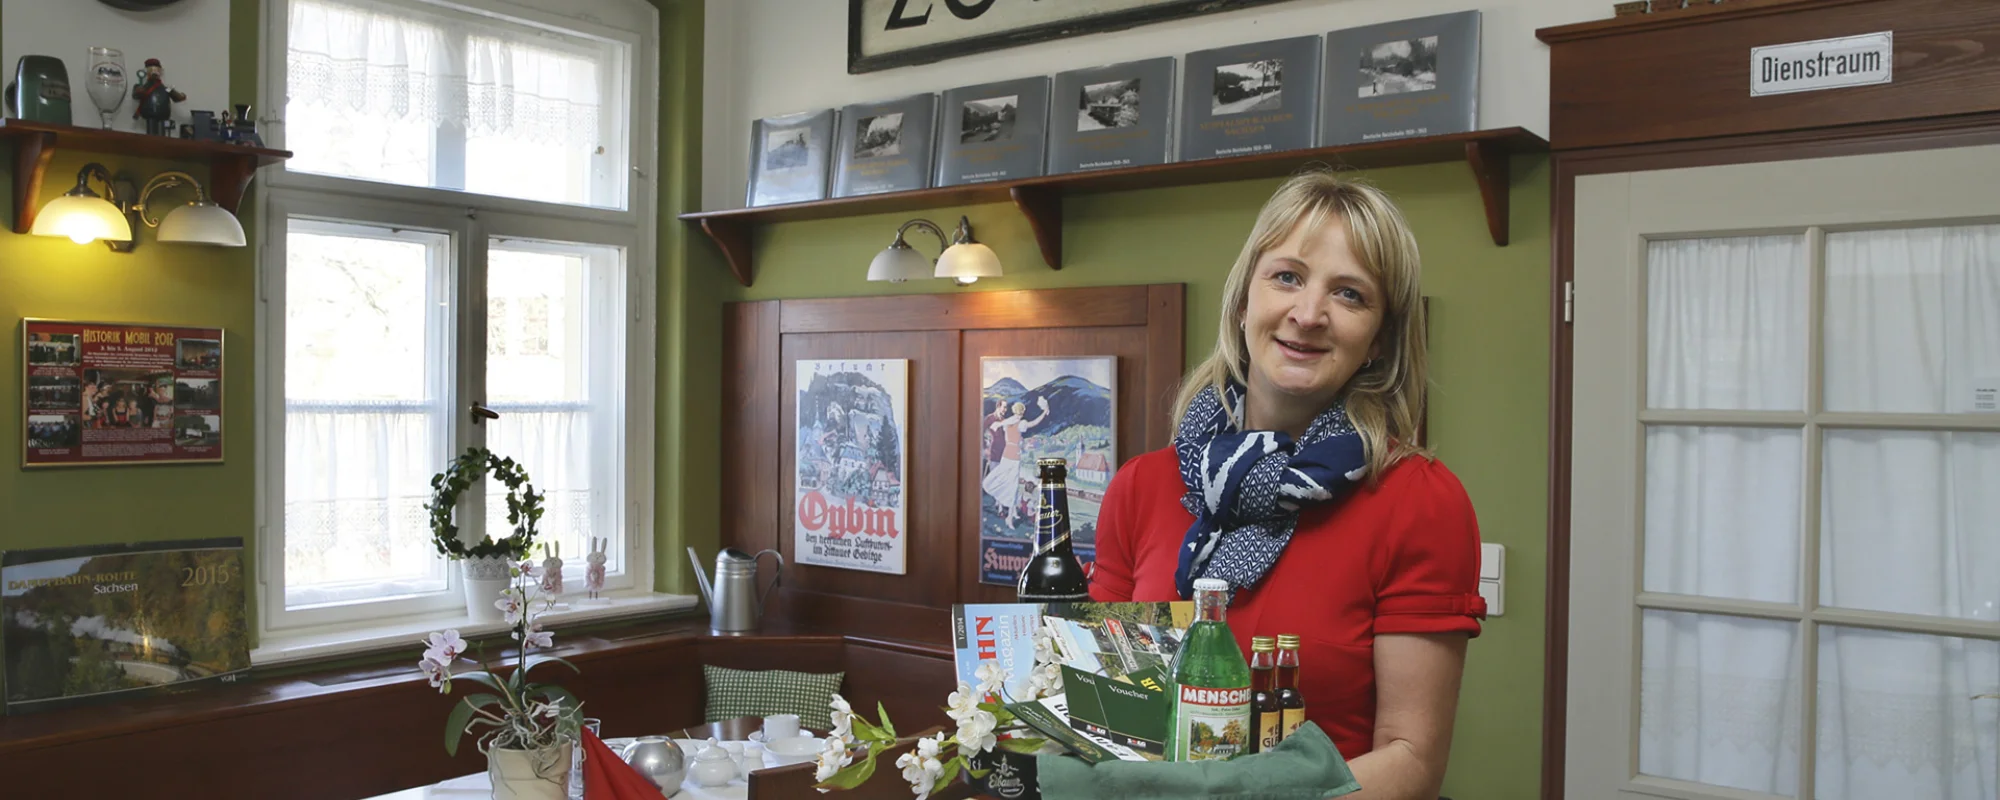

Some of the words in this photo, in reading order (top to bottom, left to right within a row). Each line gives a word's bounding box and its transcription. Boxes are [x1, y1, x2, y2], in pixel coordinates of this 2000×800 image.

[1762, 50, 1880, 83] Dienstraum
[83, 329, 121, 344] HISTORIK
[125, 331, 150, 345] MOBIL
[155, 332, 174, 346] 2012
[798, 491, 899, 539] Oybin
[983, 547, 1031, 571] Kuror
[182, 565, 230, 587] 2015
[93, 582, 139, 595] Sachsen
[1108, 684, 1149, 700] Voucher
